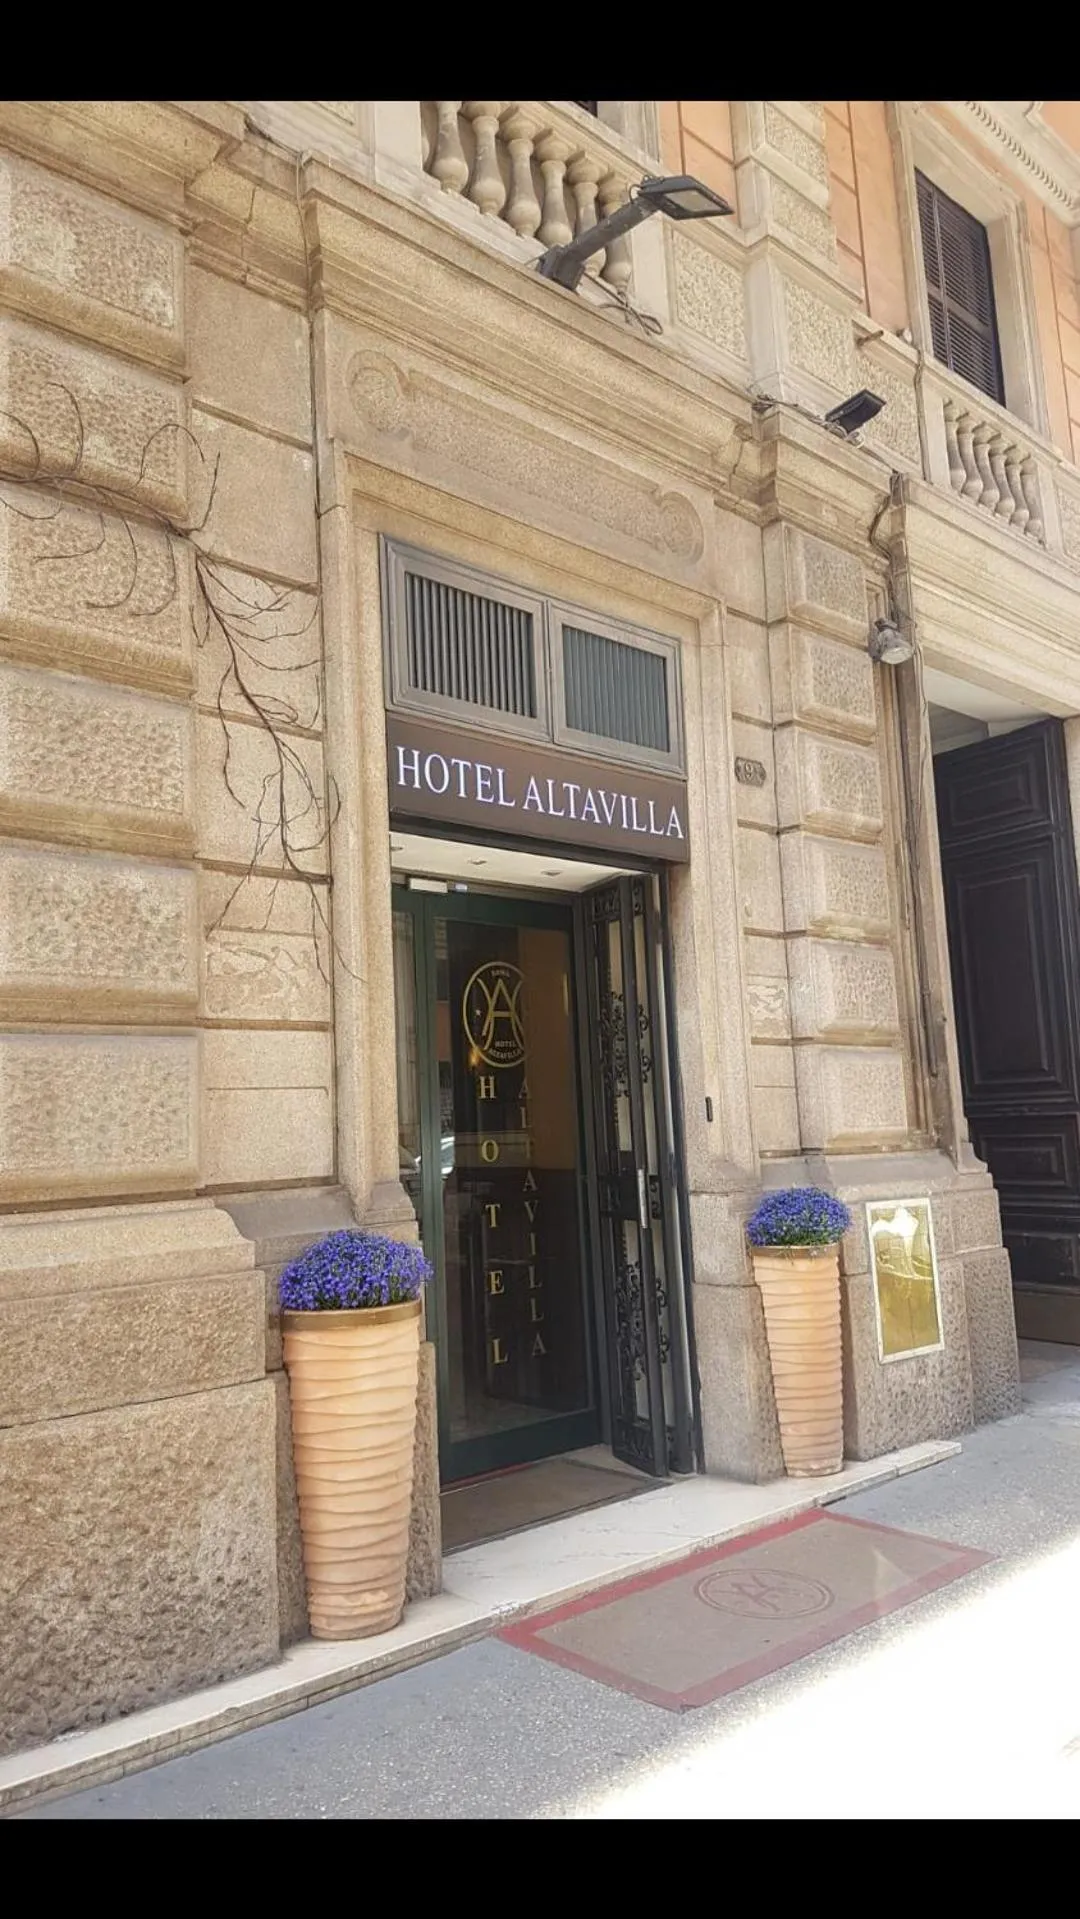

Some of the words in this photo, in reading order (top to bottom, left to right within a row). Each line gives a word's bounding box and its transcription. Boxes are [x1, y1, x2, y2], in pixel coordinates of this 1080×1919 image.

[396, 745, 516, 808] HOTEL
[522, 775, 685, 840] ALTAVILLA
[479, 1075, 509, 1365] HOTEL
[518, 1076, 548, 1357] ALTAVILLA
